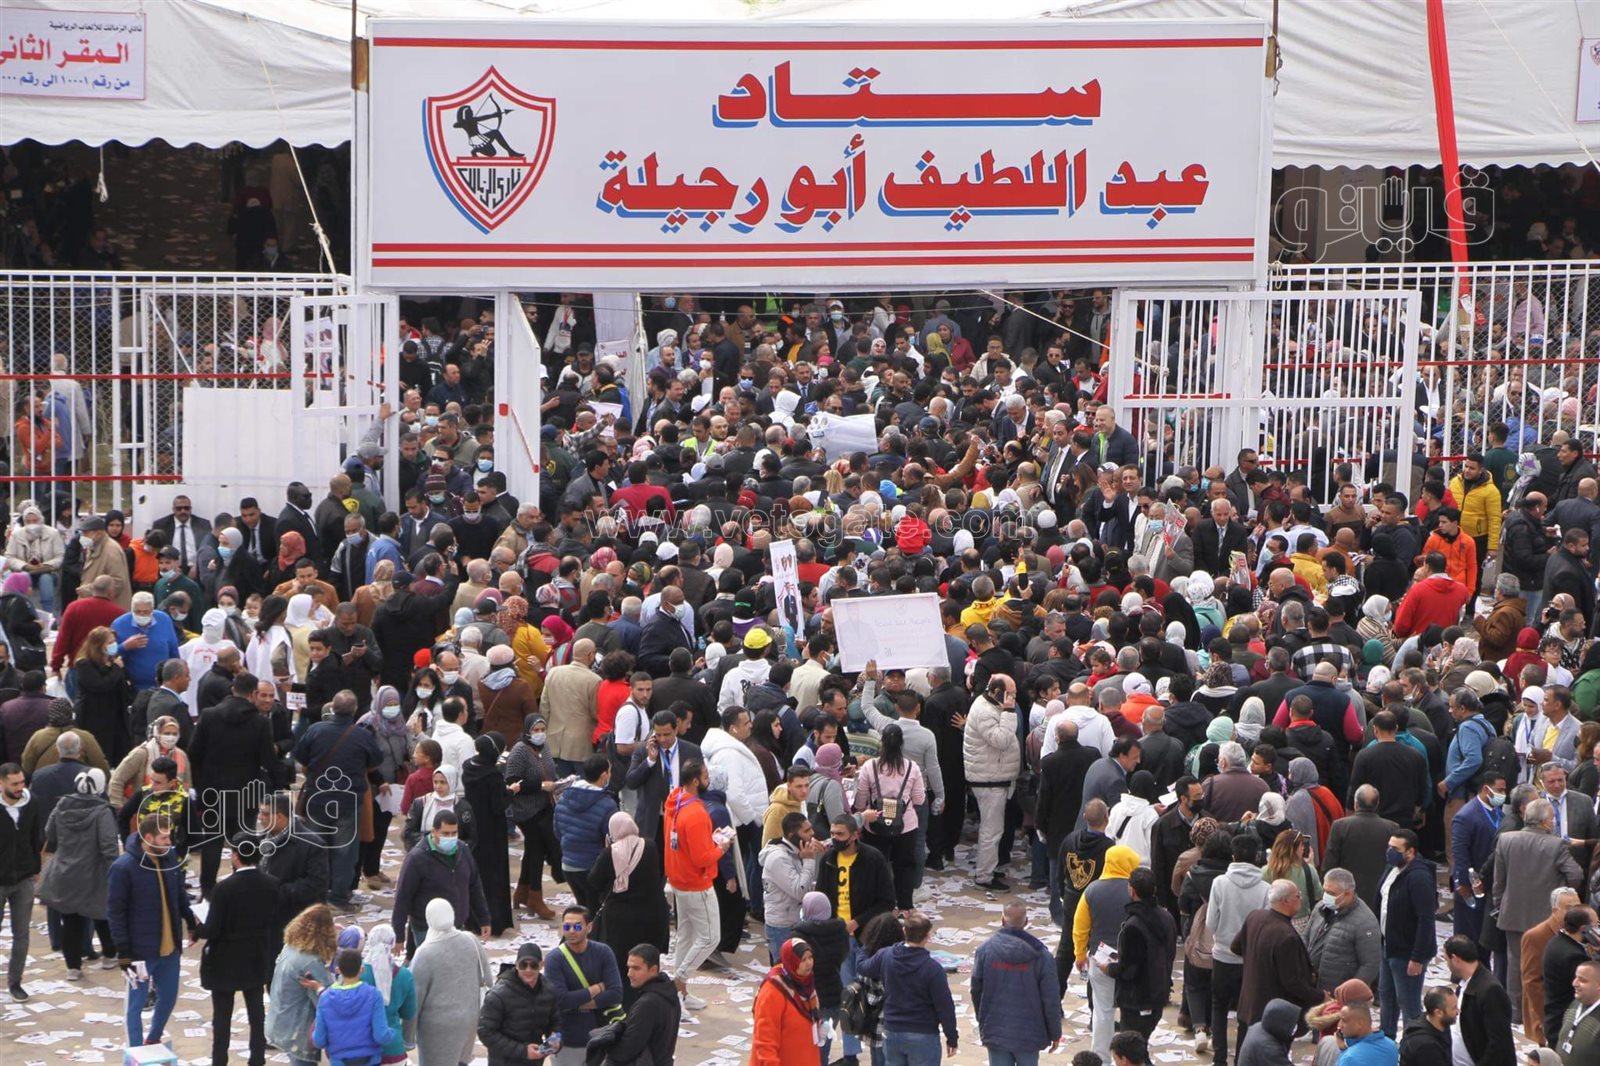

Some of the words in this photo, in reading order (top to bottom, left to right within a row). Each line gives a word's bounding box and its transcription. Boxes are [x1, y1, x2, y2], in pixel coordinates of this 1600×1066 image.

[20, 72, 39, 87] رقم
[56, 39, 128, 68] المقر
[92, 74, 111, 89] رقم
[114, 77, 130, 90] من
[713, 60, 1101, 127] ستاد
[596, 150, 770, 234] رجيلة
[775, 133, 866, 233] أبو
[877, 148, 1087, 231] اللطيف
[1100, 161, 1209, 230] عبد
